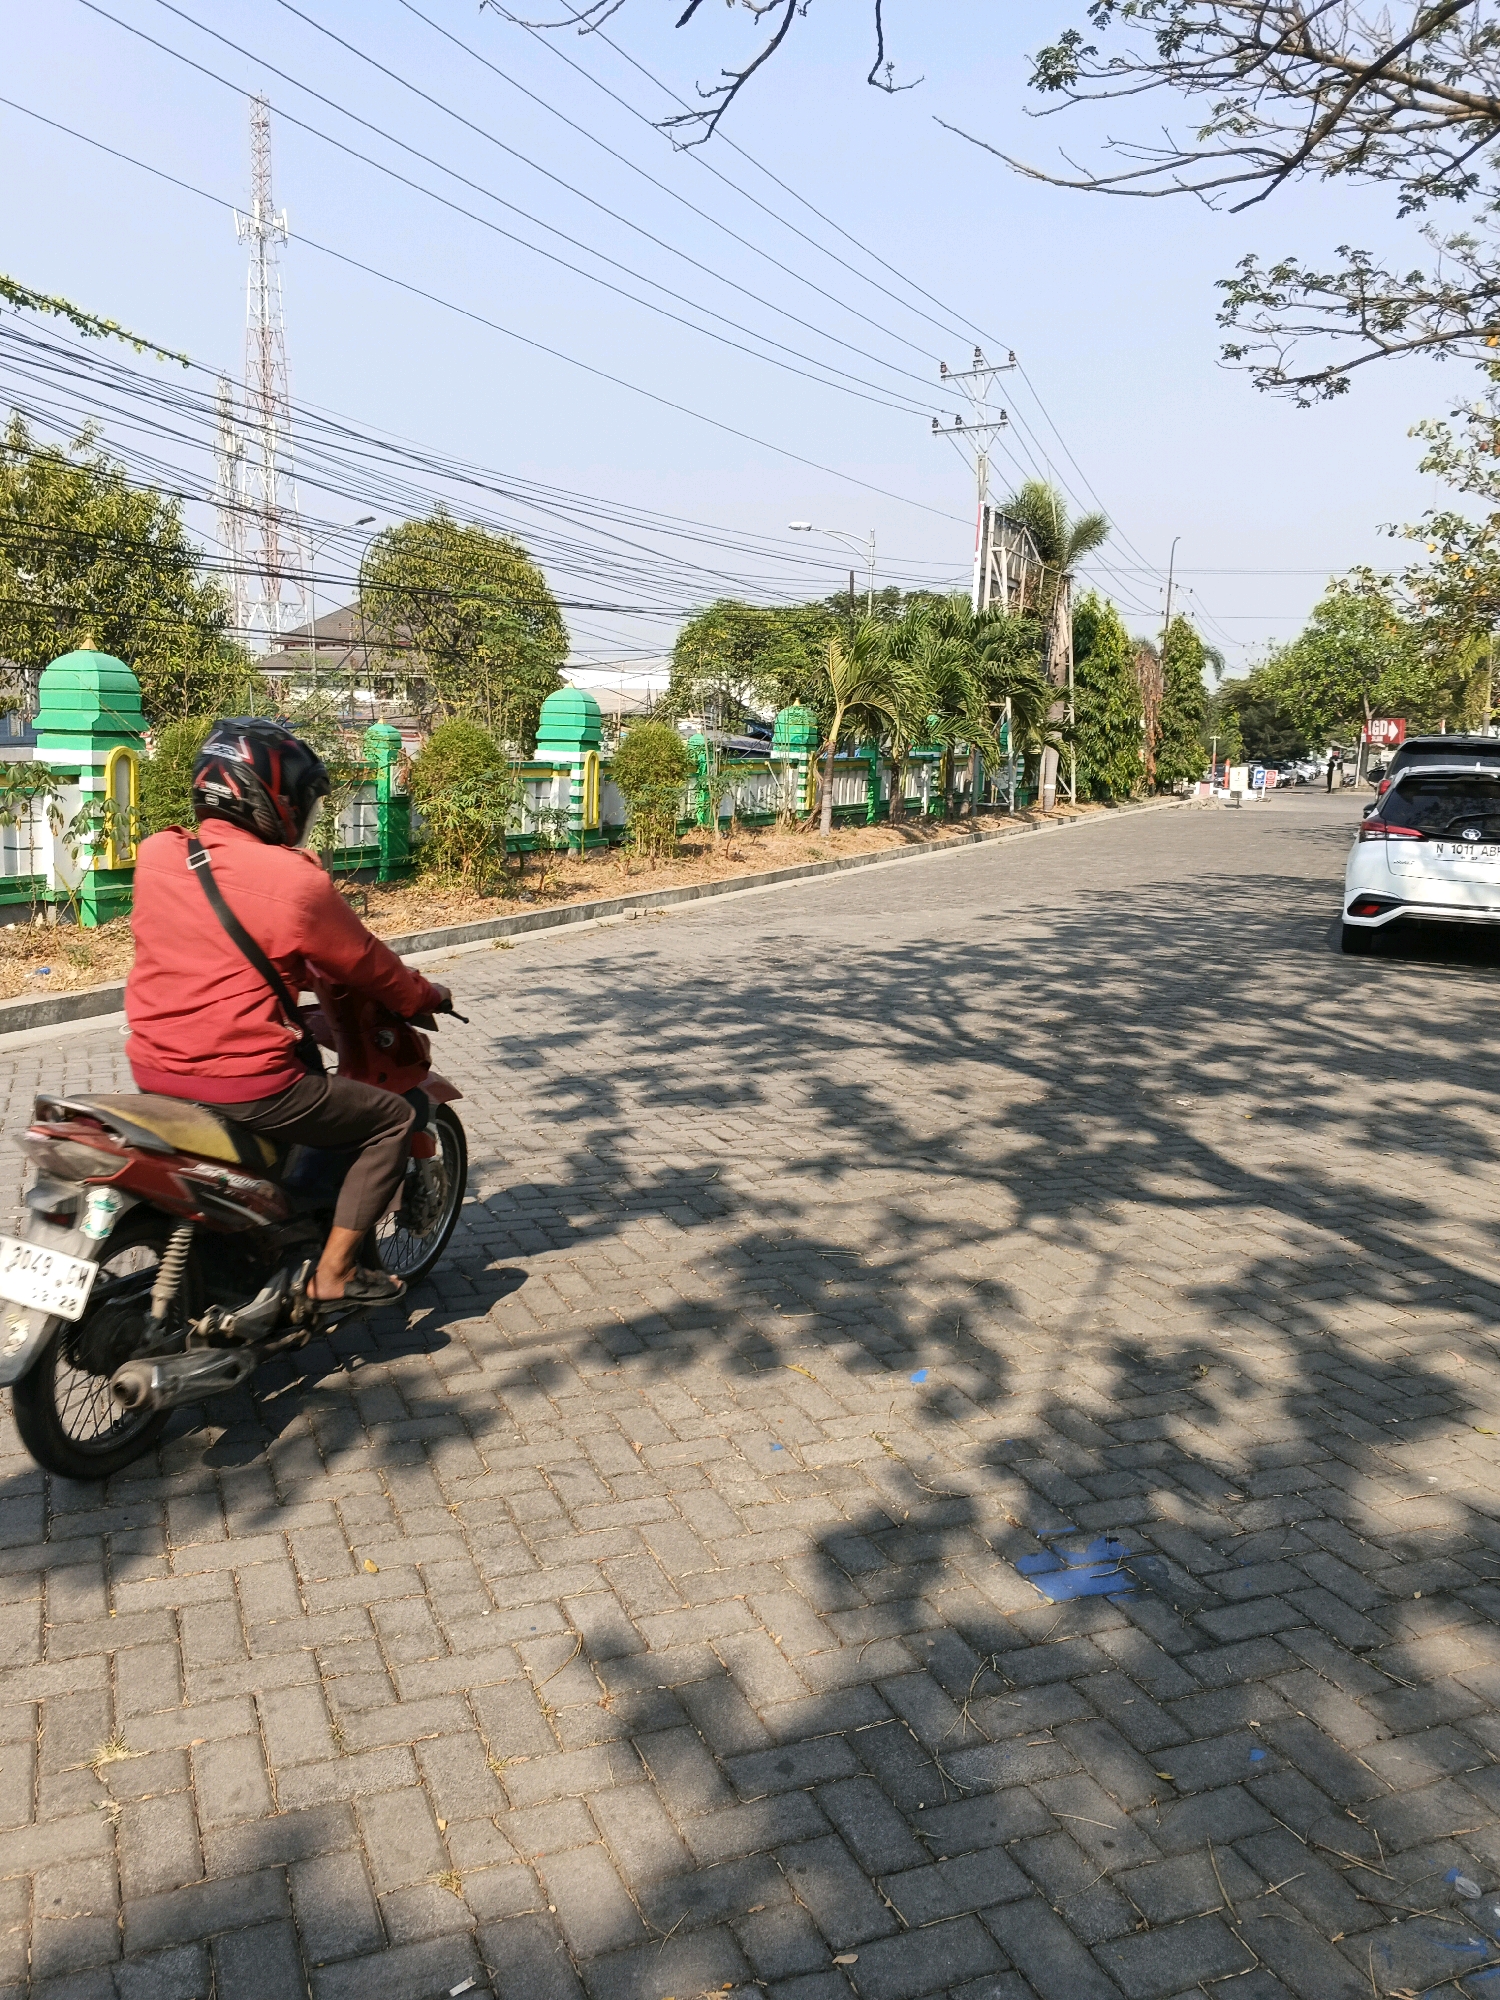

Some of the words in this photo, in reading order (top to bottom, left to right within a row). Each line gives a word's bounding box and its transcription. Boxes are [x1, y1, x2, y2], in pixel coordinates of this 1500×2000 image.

[1367, 719, 1388, 736] IGD
[1436, 843, 1444, 854] N
[1451, 844, 1474, 855] 1011
[6, 1246, 54, 1277] 2049
